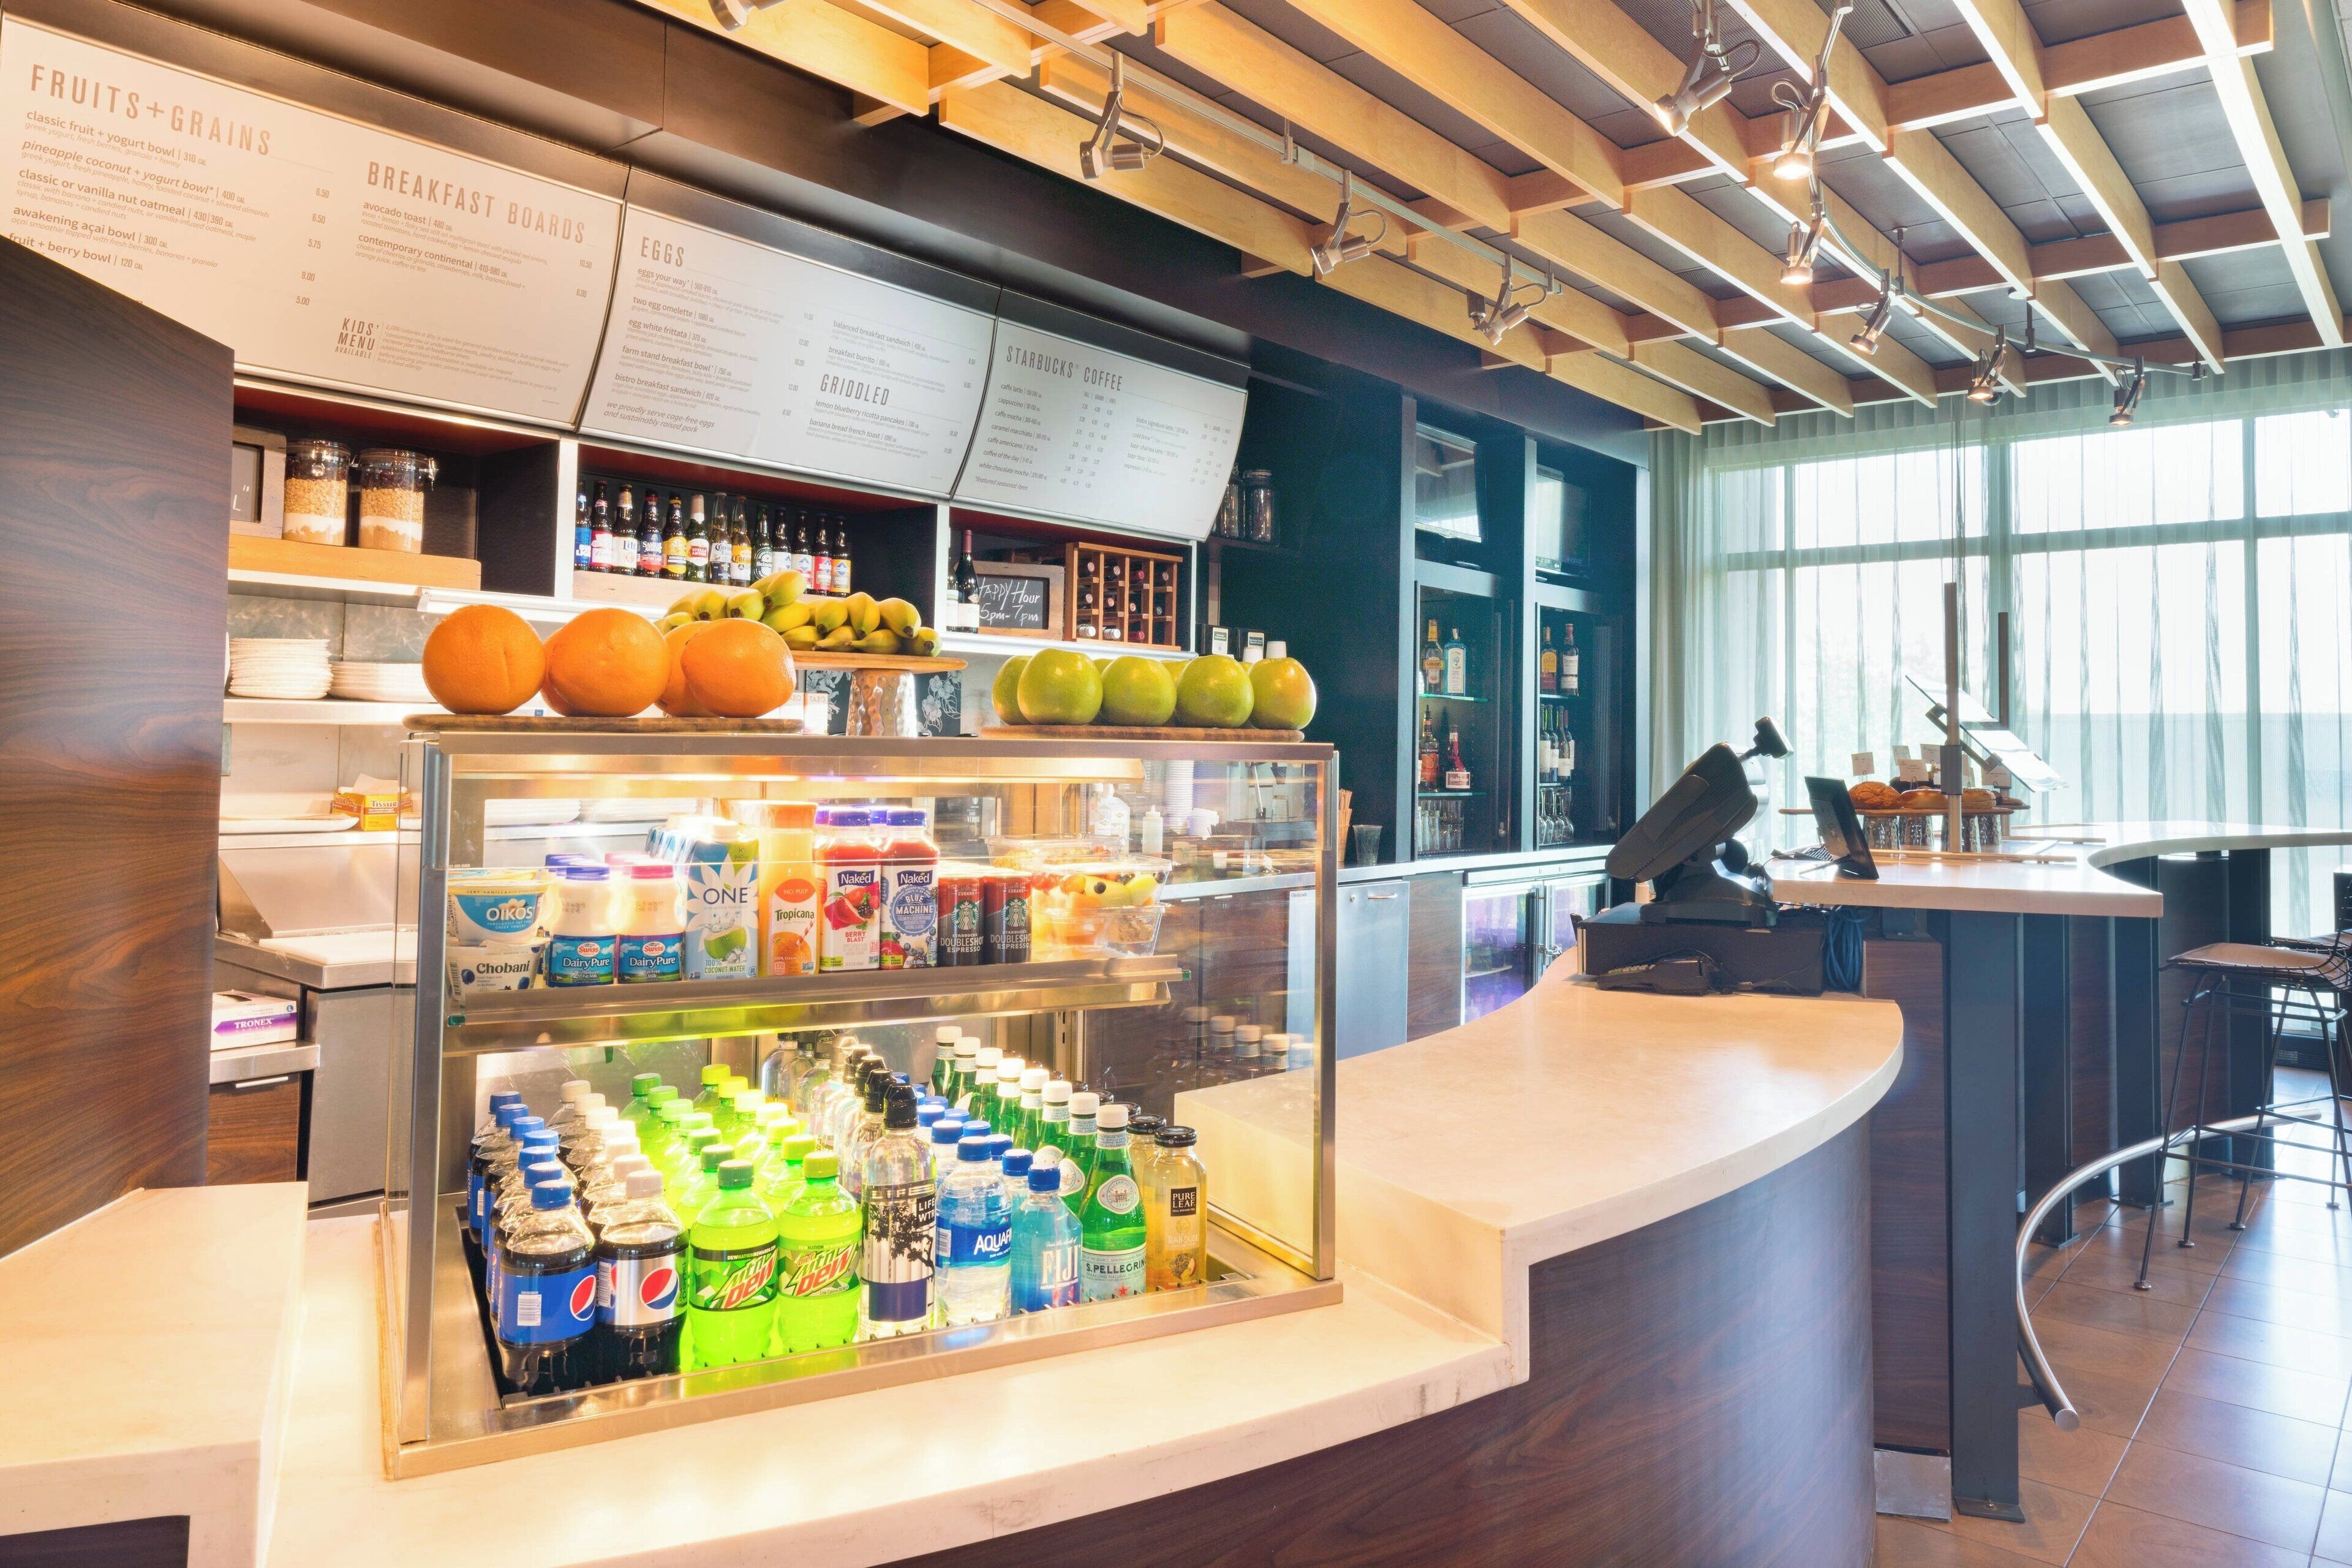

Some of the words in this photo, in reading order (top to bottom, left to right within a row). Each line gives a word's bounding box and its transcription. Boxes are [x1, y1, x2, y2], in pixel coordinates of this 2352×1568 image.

[30, 64, 271, 156] FRUITS+GRAINS
[27, 111, 66, 128] classic
[69, 121, 94, 135] fruit
[107, 134, 145, 149] yogurt
[148, 141, 174, 157] bowl
[184, 152, 195, 162] 310
[22, 141, 83, 165] pineapple
[86, 157, 131, 174] coconut
[143, 172, 180, 190] yogurt
[222, 190, 235, 200] 400
[20, 169, 58, 185] classic
[77, 184, 114, 198] vanilla
[118, 194, 137, 205] nut
[140, 200, 184, 216] oatmeal
[316, 187, 330, 198] 6.50
[367, 161, 495, 218] BREAKFAST
[507, 202, 585, 244] BOARDS
[312, 213, 326, 224] 6.50
[363, 202, 401, 217] avocado
[404, 211, 426, 224] toast
[13, 207, 78, 230] awakening
[81, 223, 105, 234] açai
[108, 226, 135, 241] bowl
[144, 235, 157, 245] 300
[307, 238, 321, 249] 5.75
[358, 235, 423, 257] contemporary
[424, 251, 472, 268] continental
[641, 236, 685, 268] EGGS
[48, 241, 80, 257] berry
[83, 249, 111, 263] bowl
[121, 258, 132, 267] 120
[579, 260, 592, 269] 10.50
[301, 271, 315, 282] 9.00
[638, 268, 654, 278] eggs
[655, 273, 671, 284] your
[296, 296, 310, 306] 5.00
[633, 296, 646, 305] two
[648, 301, 660, 311] egg
[662, 305, 692, 317] omelette
[628, 320, 641, 329] egg
[643, 322, 662, 332] white
[663, 326, 687, 338] frittata
[833, 320, 859, 333] balanced
[859, 328, 884, 340] breakfast
[886, 336, 910, 347] sandwich
[337, 333, 375, 350] MENU
[334, 346, 372, 359] AVAILABLE
[622, 345, 639, 355] farm
[640, 351, 660, 360] stand
[662, 354, 693, 368] breakfast
[828, 345, 854, 358] breakfast
[856, 353, 875, 363] burrito
[1006, 345, 1073, 379] STARBUCKS
[1084, 366, 1122, 391] COFFEE
[615, 372, 635, 383] bistro
[637, 377, 669, 391] breakfast
[670, 386, 701, 397] sandwich
[821, 374, 889, 405] GRIDDLED
[998, 397, 1023, 408] cappuccino
[618, 404, 645, 415] proudly
[646, 409, 665, 418] serve
[666, 413, 698, 424] cage-free
[815, 399, 833, 409] lemon
[834, 404, 861, 417] blueberry
[862, 410, 879, 419] ricotta
[880, 416, 905, 425] pancakes
[619, 412, 659, 426] sustainably
[681, 423, 698, 432] pork
[809, 418, 830, 428] banana
[831, 423, 848, 432] bread
[848, 426, 865, 435] french
[991, 424, 1009, 432] caramel
[1011, 428, 1033, 437] macchiato
[999, 440, 1023, 449] americano
[992, 466, 1014, 475] chocolate
[1011, 579, 1040, 603] Hour
[842, 873, 871, 883] Naked
[900, 873, 930, 883] Naked
[703, 887, 748, 904] ONE
[775, 908, 815, 921] Tropicana
[896, 905, 933, 915] MACHINE
[990, 933, 1031, 943] DOUBLESHO
[477, 960, 530, 974] Chobani
[234, 1018, 272, 1029] TRONEX
[919, 1197, 935, 1211] LIFE
[1173, 1192, 1196, 1200] PURE
[1173, 1199, 1195, 1208] LEAF
[919, 1209, 935, 1223] WTR
[974, 1228, 1011, 1255] AQUAF
[1042, 1245, 1080, 1284] FIJI
